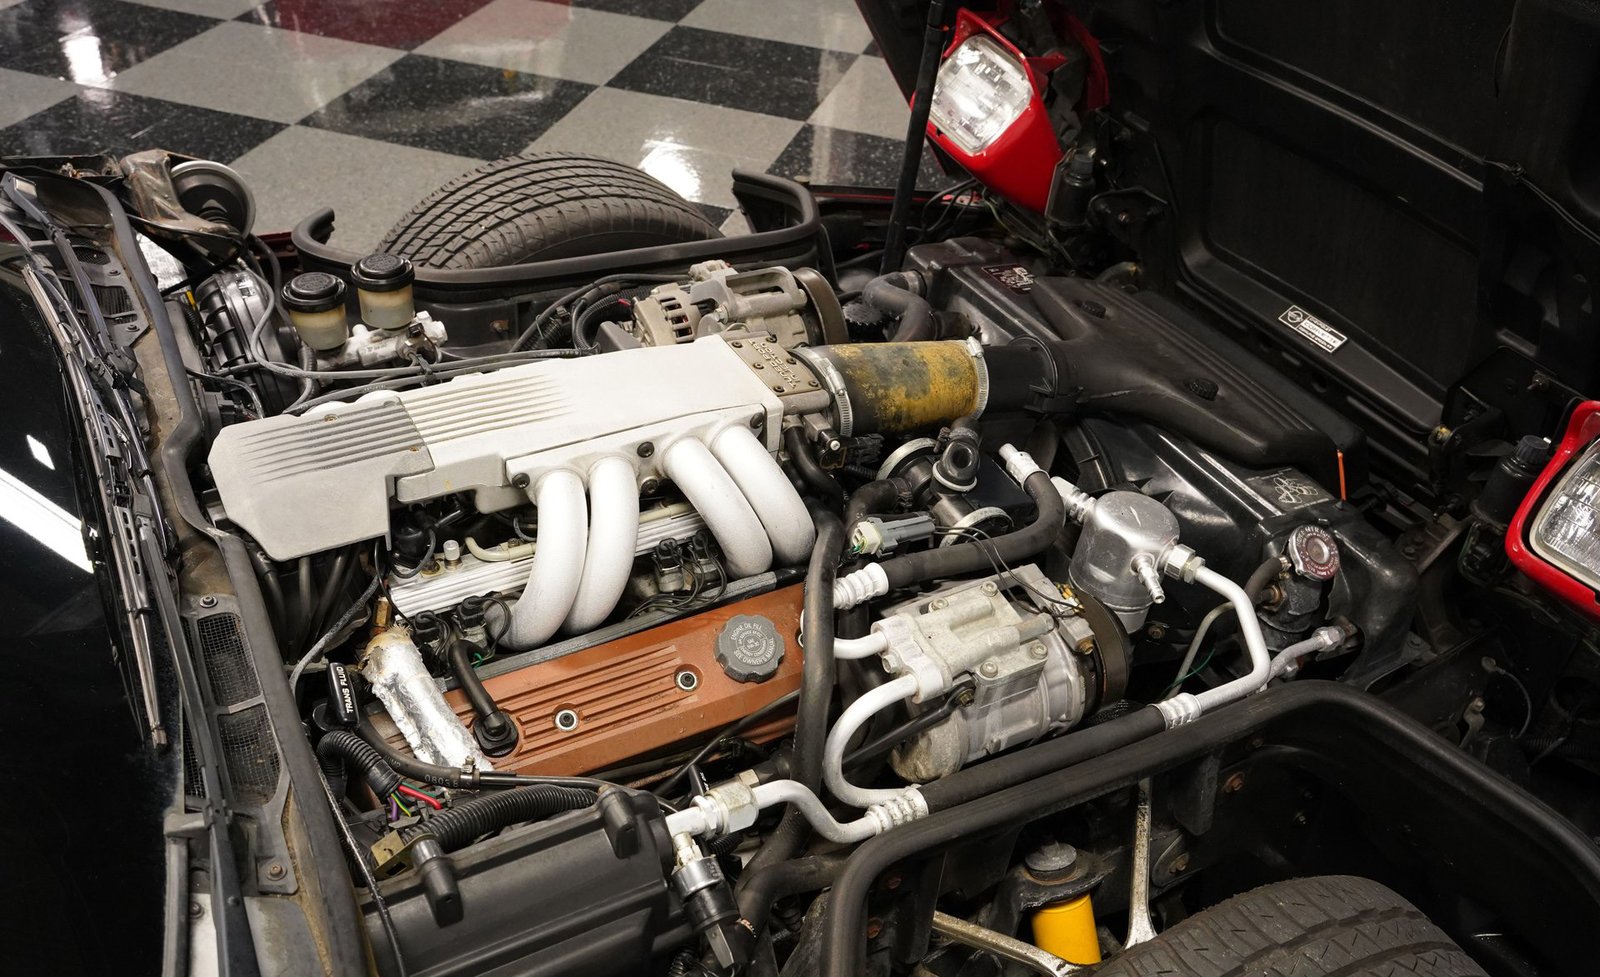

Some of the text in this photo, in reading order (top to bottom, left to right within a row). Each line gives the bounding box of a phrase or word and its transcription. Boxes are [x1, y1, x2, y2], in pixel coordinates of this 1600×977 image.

[747, 339, 796, 388] TUNED PORT
[760, 342, 801, 382] INJECTION
[731, 625, 743, 640] ENGINE
[753, 622, 762, 630] FILL
[733, 650, 742, 659] SEE
[742, 657, 768, 665] OWNER'S
[765, 637, 774, 658] MANUAL
[336, 666, 354, 714] TRANS FLUID
